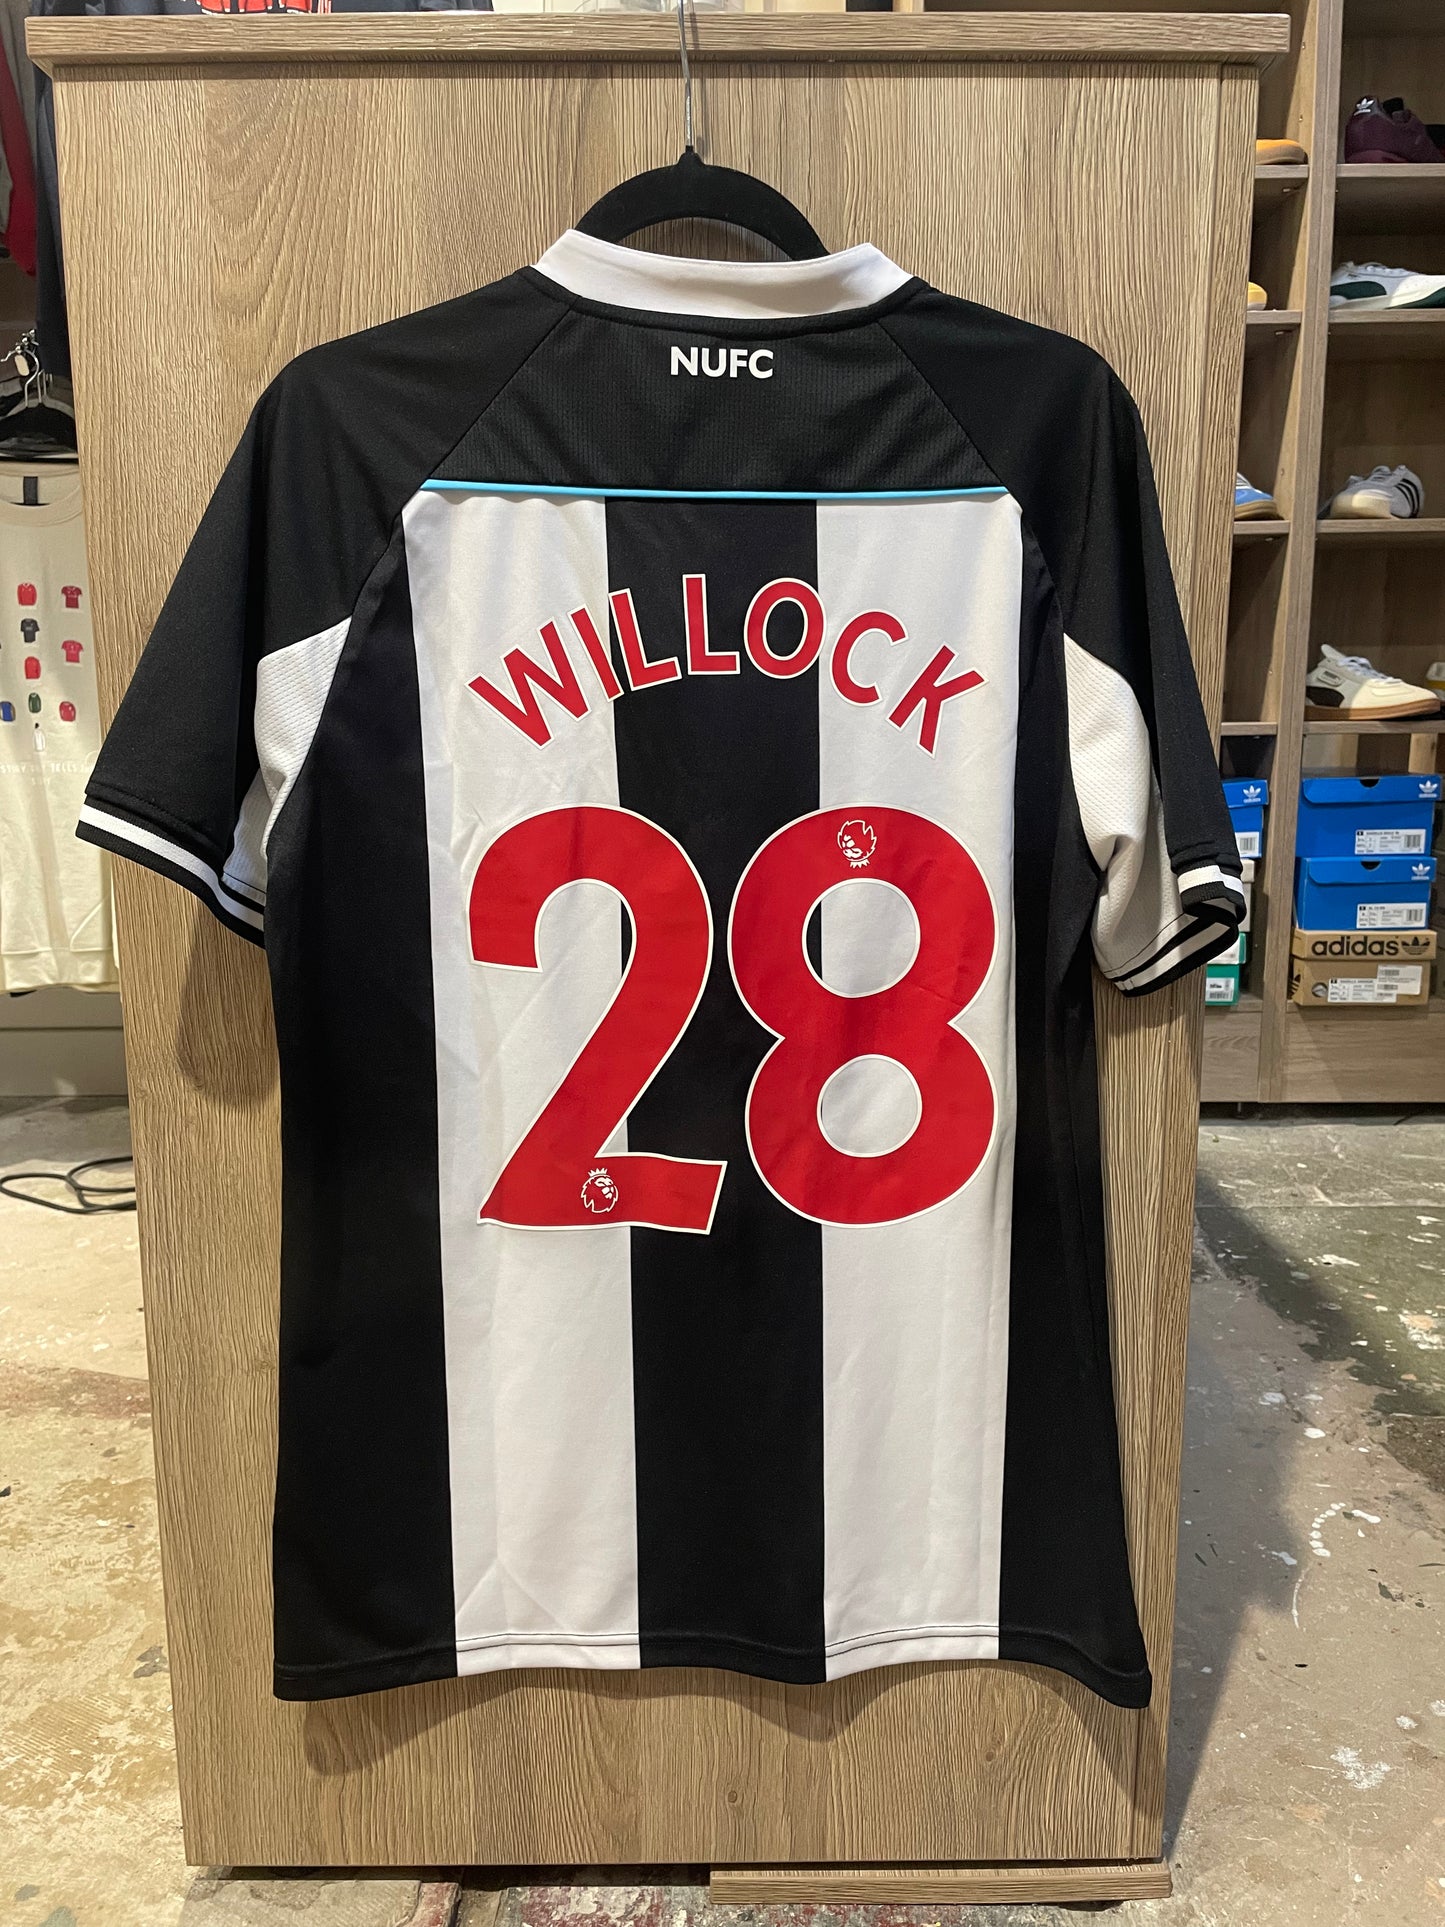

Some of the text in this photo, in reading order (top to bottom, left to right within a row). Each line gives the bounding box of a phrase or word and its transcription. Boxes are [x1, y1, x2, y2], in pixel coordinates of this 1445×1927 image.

[670, 345, 774, 379] NUFC
[464, 573, 989, 758] WILLOCK
[1311, 935, 1398, 956] adidas
[466, 803, 999, 1235] 28
